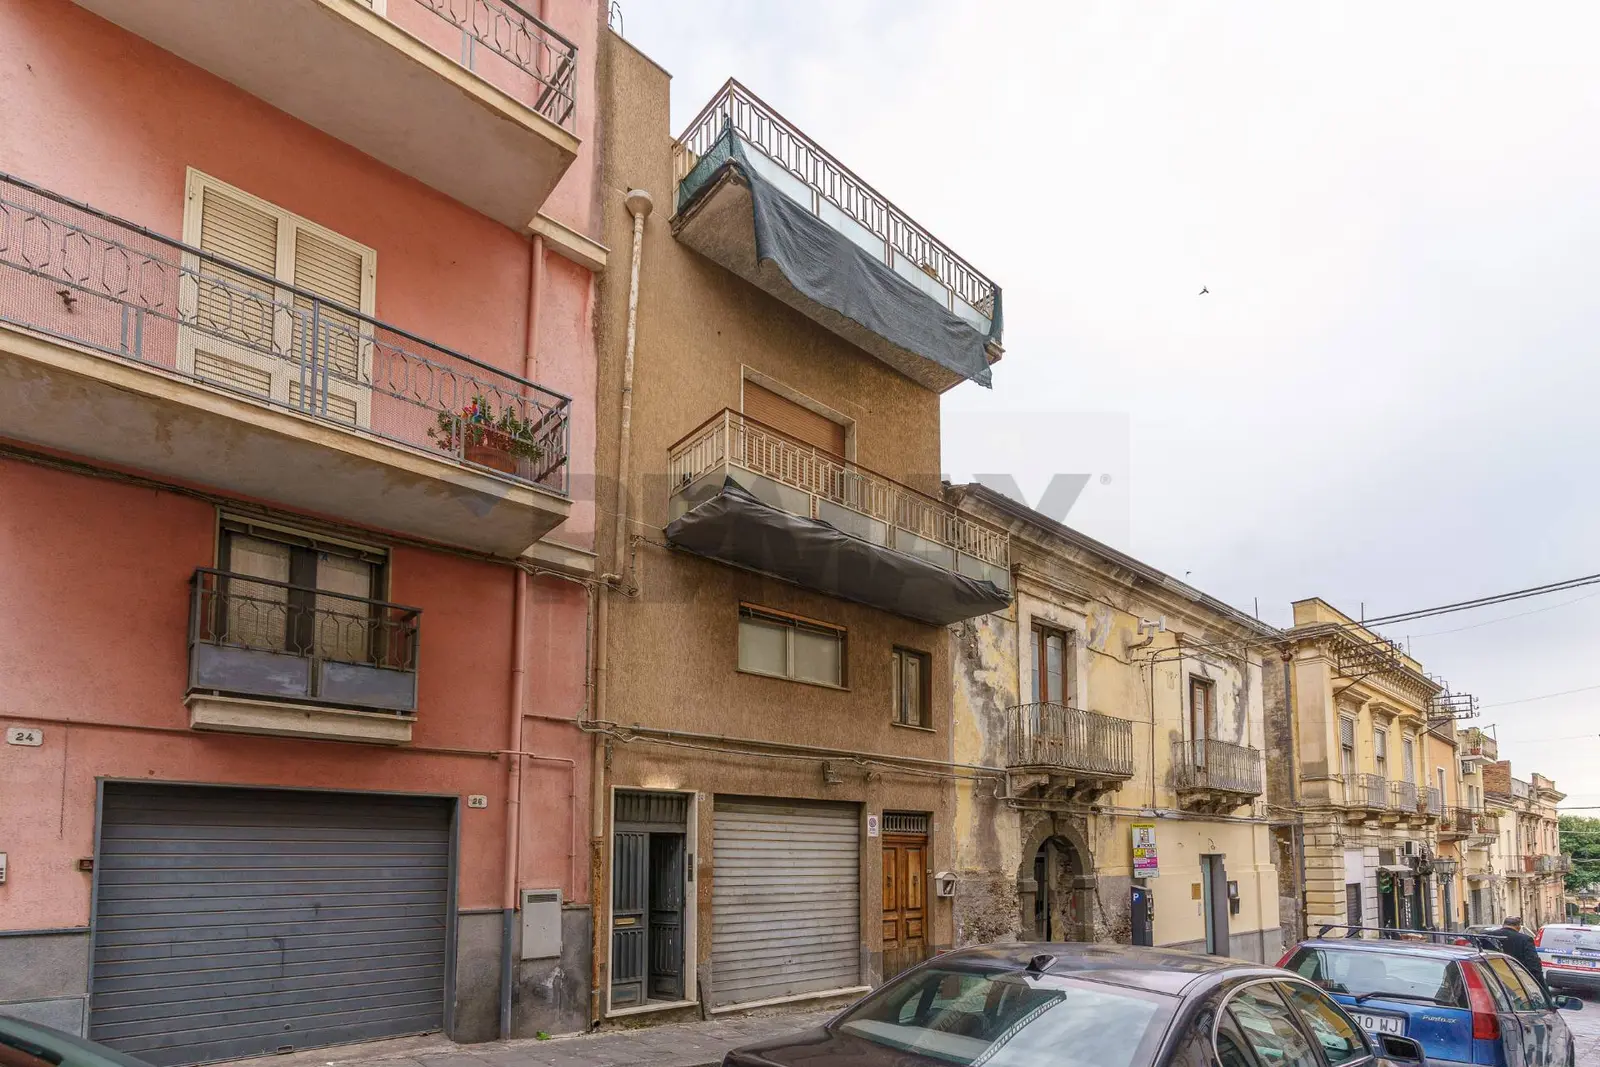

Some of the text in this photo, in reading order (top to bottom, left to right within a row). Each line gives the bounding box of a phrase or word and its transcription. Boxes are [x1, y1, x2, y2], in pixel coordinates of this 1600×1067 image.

[15, 732, 34, 742] 24
[472, 797, 483, 806] 26
[1133, 893, 1140, 901] P
[1422, 1014, 1446, 1023] Punto
[1380, 1018, 1398, 1033] WJ
